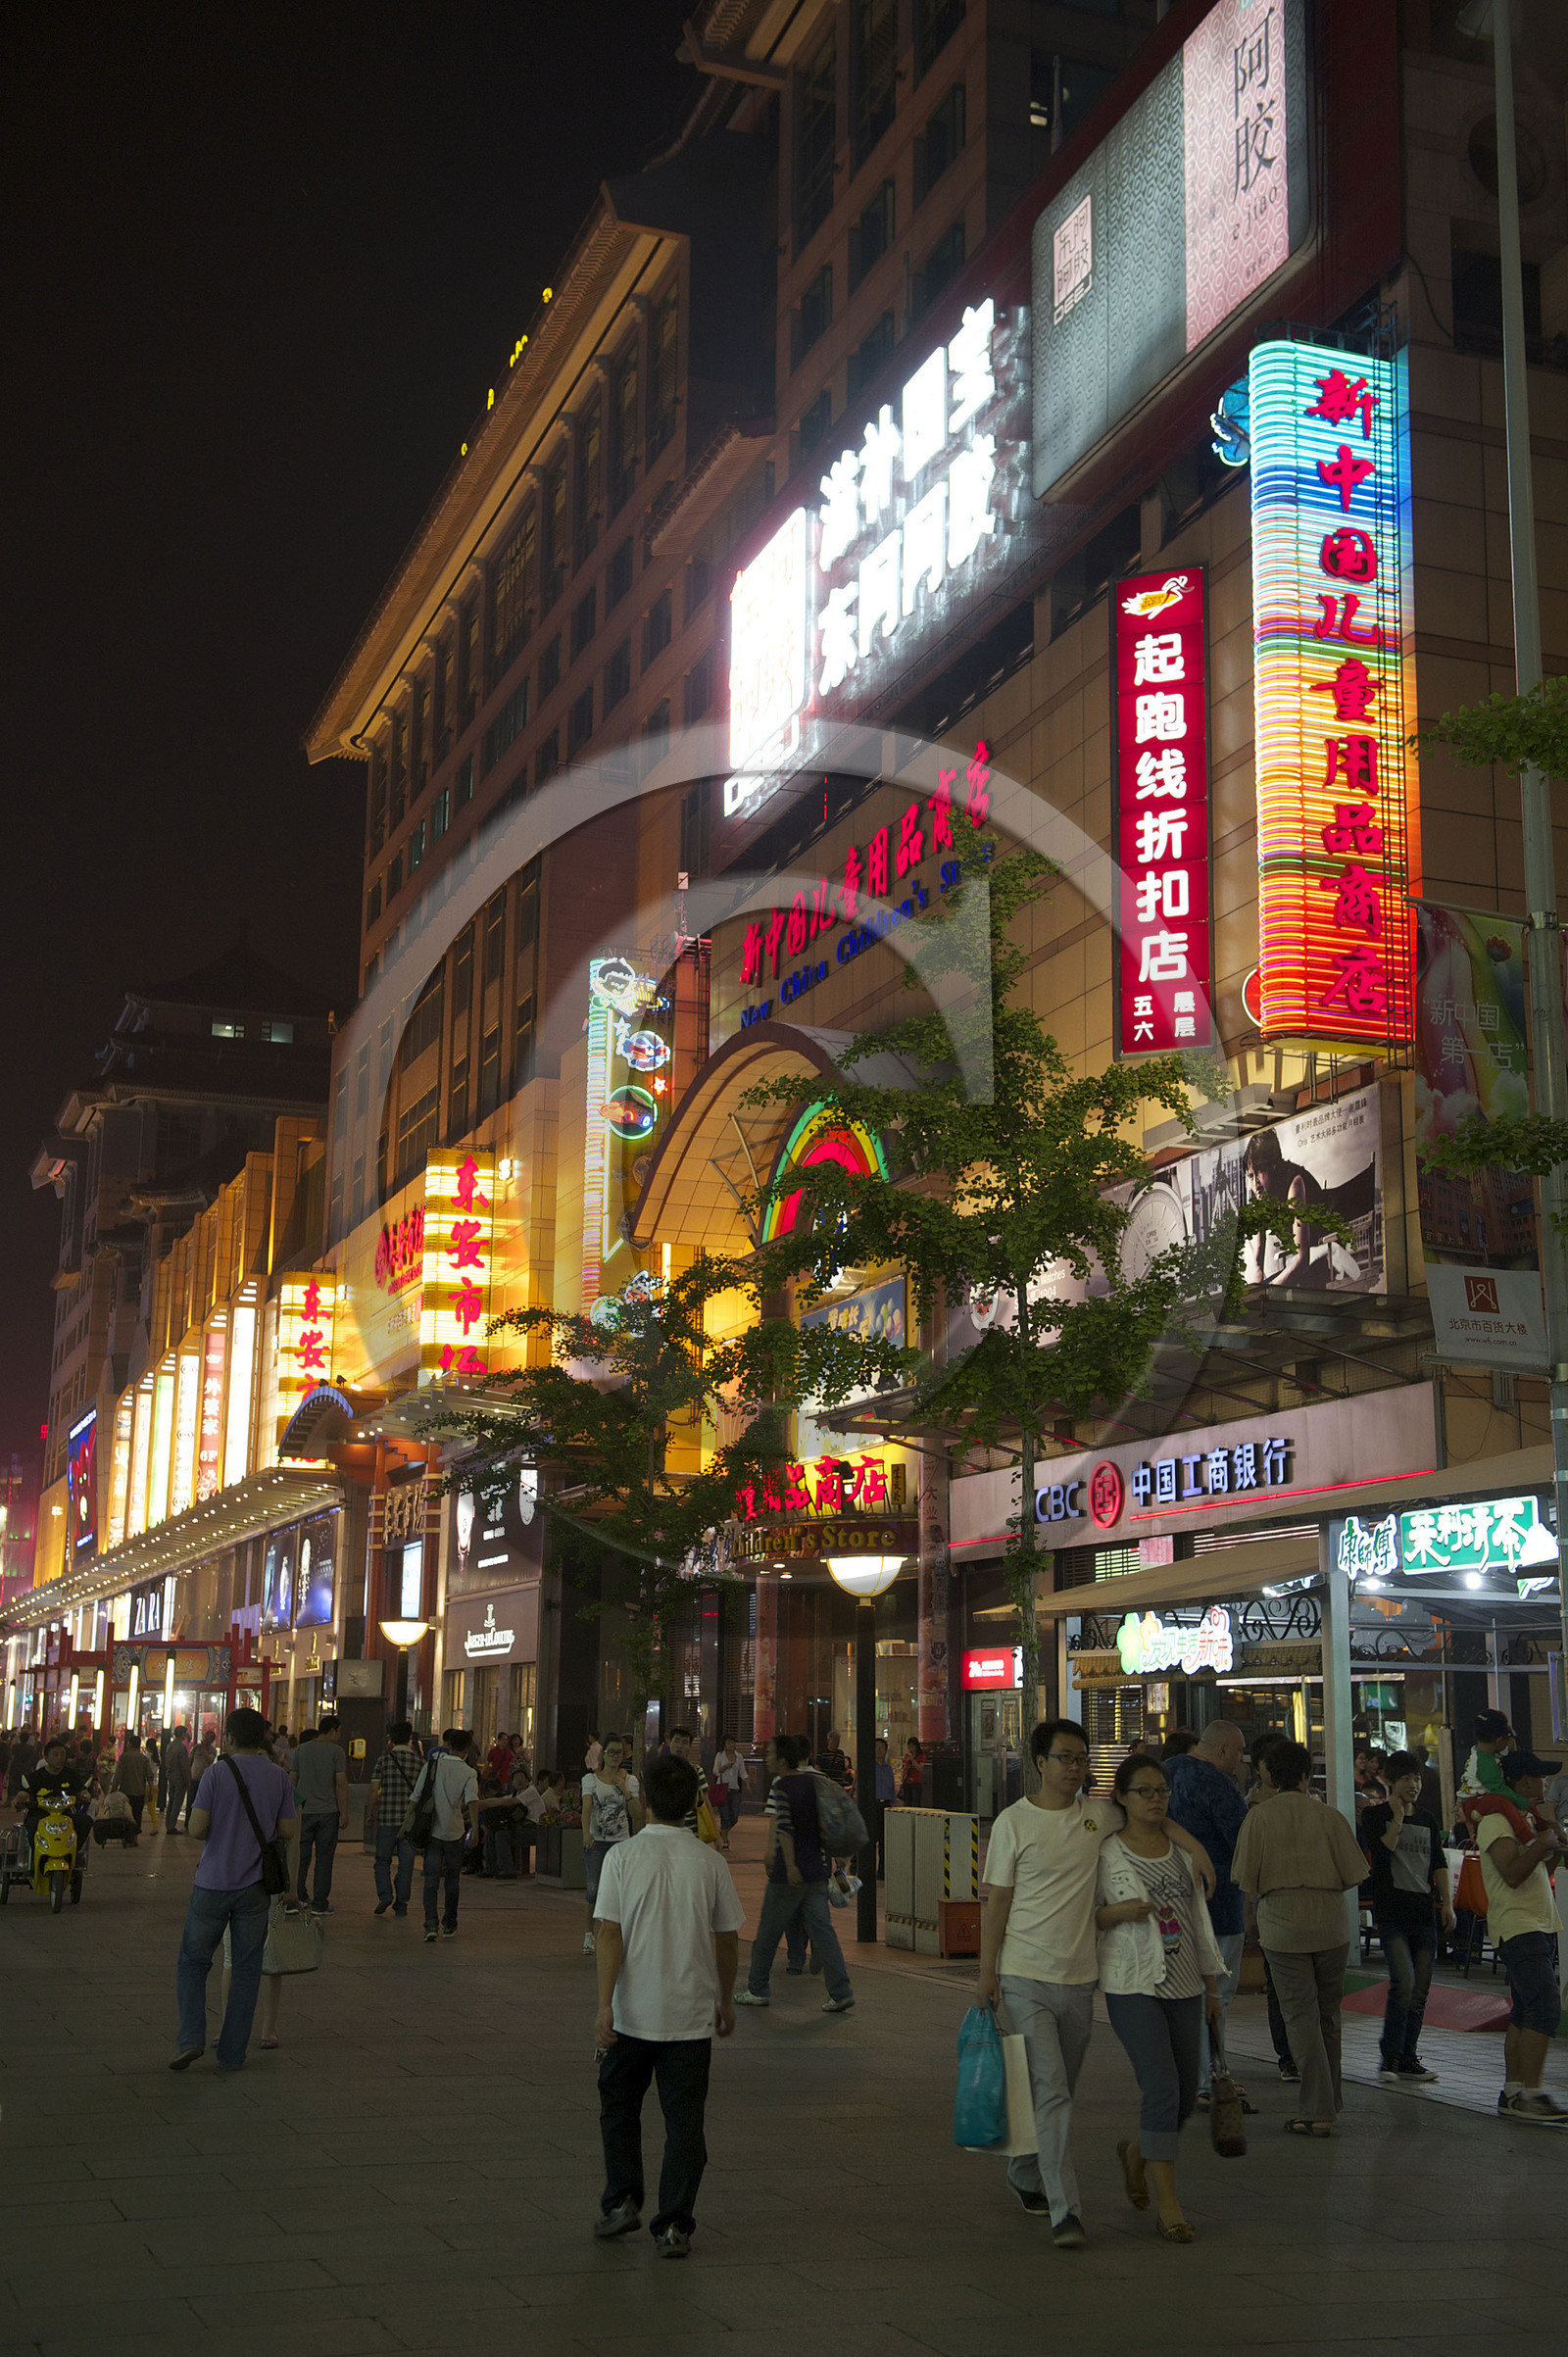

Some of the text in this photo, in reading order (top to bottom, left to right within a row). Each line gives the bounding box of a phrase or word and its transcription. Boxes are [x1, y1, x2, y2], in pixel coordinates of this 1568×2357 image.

[1233, 6, 1276, 204] 阿胶
[1054, 274, 1093, 325] DEEJ
[1306, 368, 1387, 1016] 新中国儿童用品商店
[1133, 632, 1190, 983] 起跑线折扣店
[739, 741, 991, 984] 新中国儿童用品商店
[740, 842, 993, 1029] New China Children's Ste
[438, 1154, 490, 1374] 东安市场
[1449, 1317, 1529, 1336] 北京市百货大楼
[1465, 1336, 1518, 1348] www.wfj.com.cn
[199, 1449, 219, 1462] 6F
[1131, 1437, 1288, 1507] 中国工商银行
[821, 1525, 896, 1549] Store
[133, 1592, 161, 1637] ZARA
